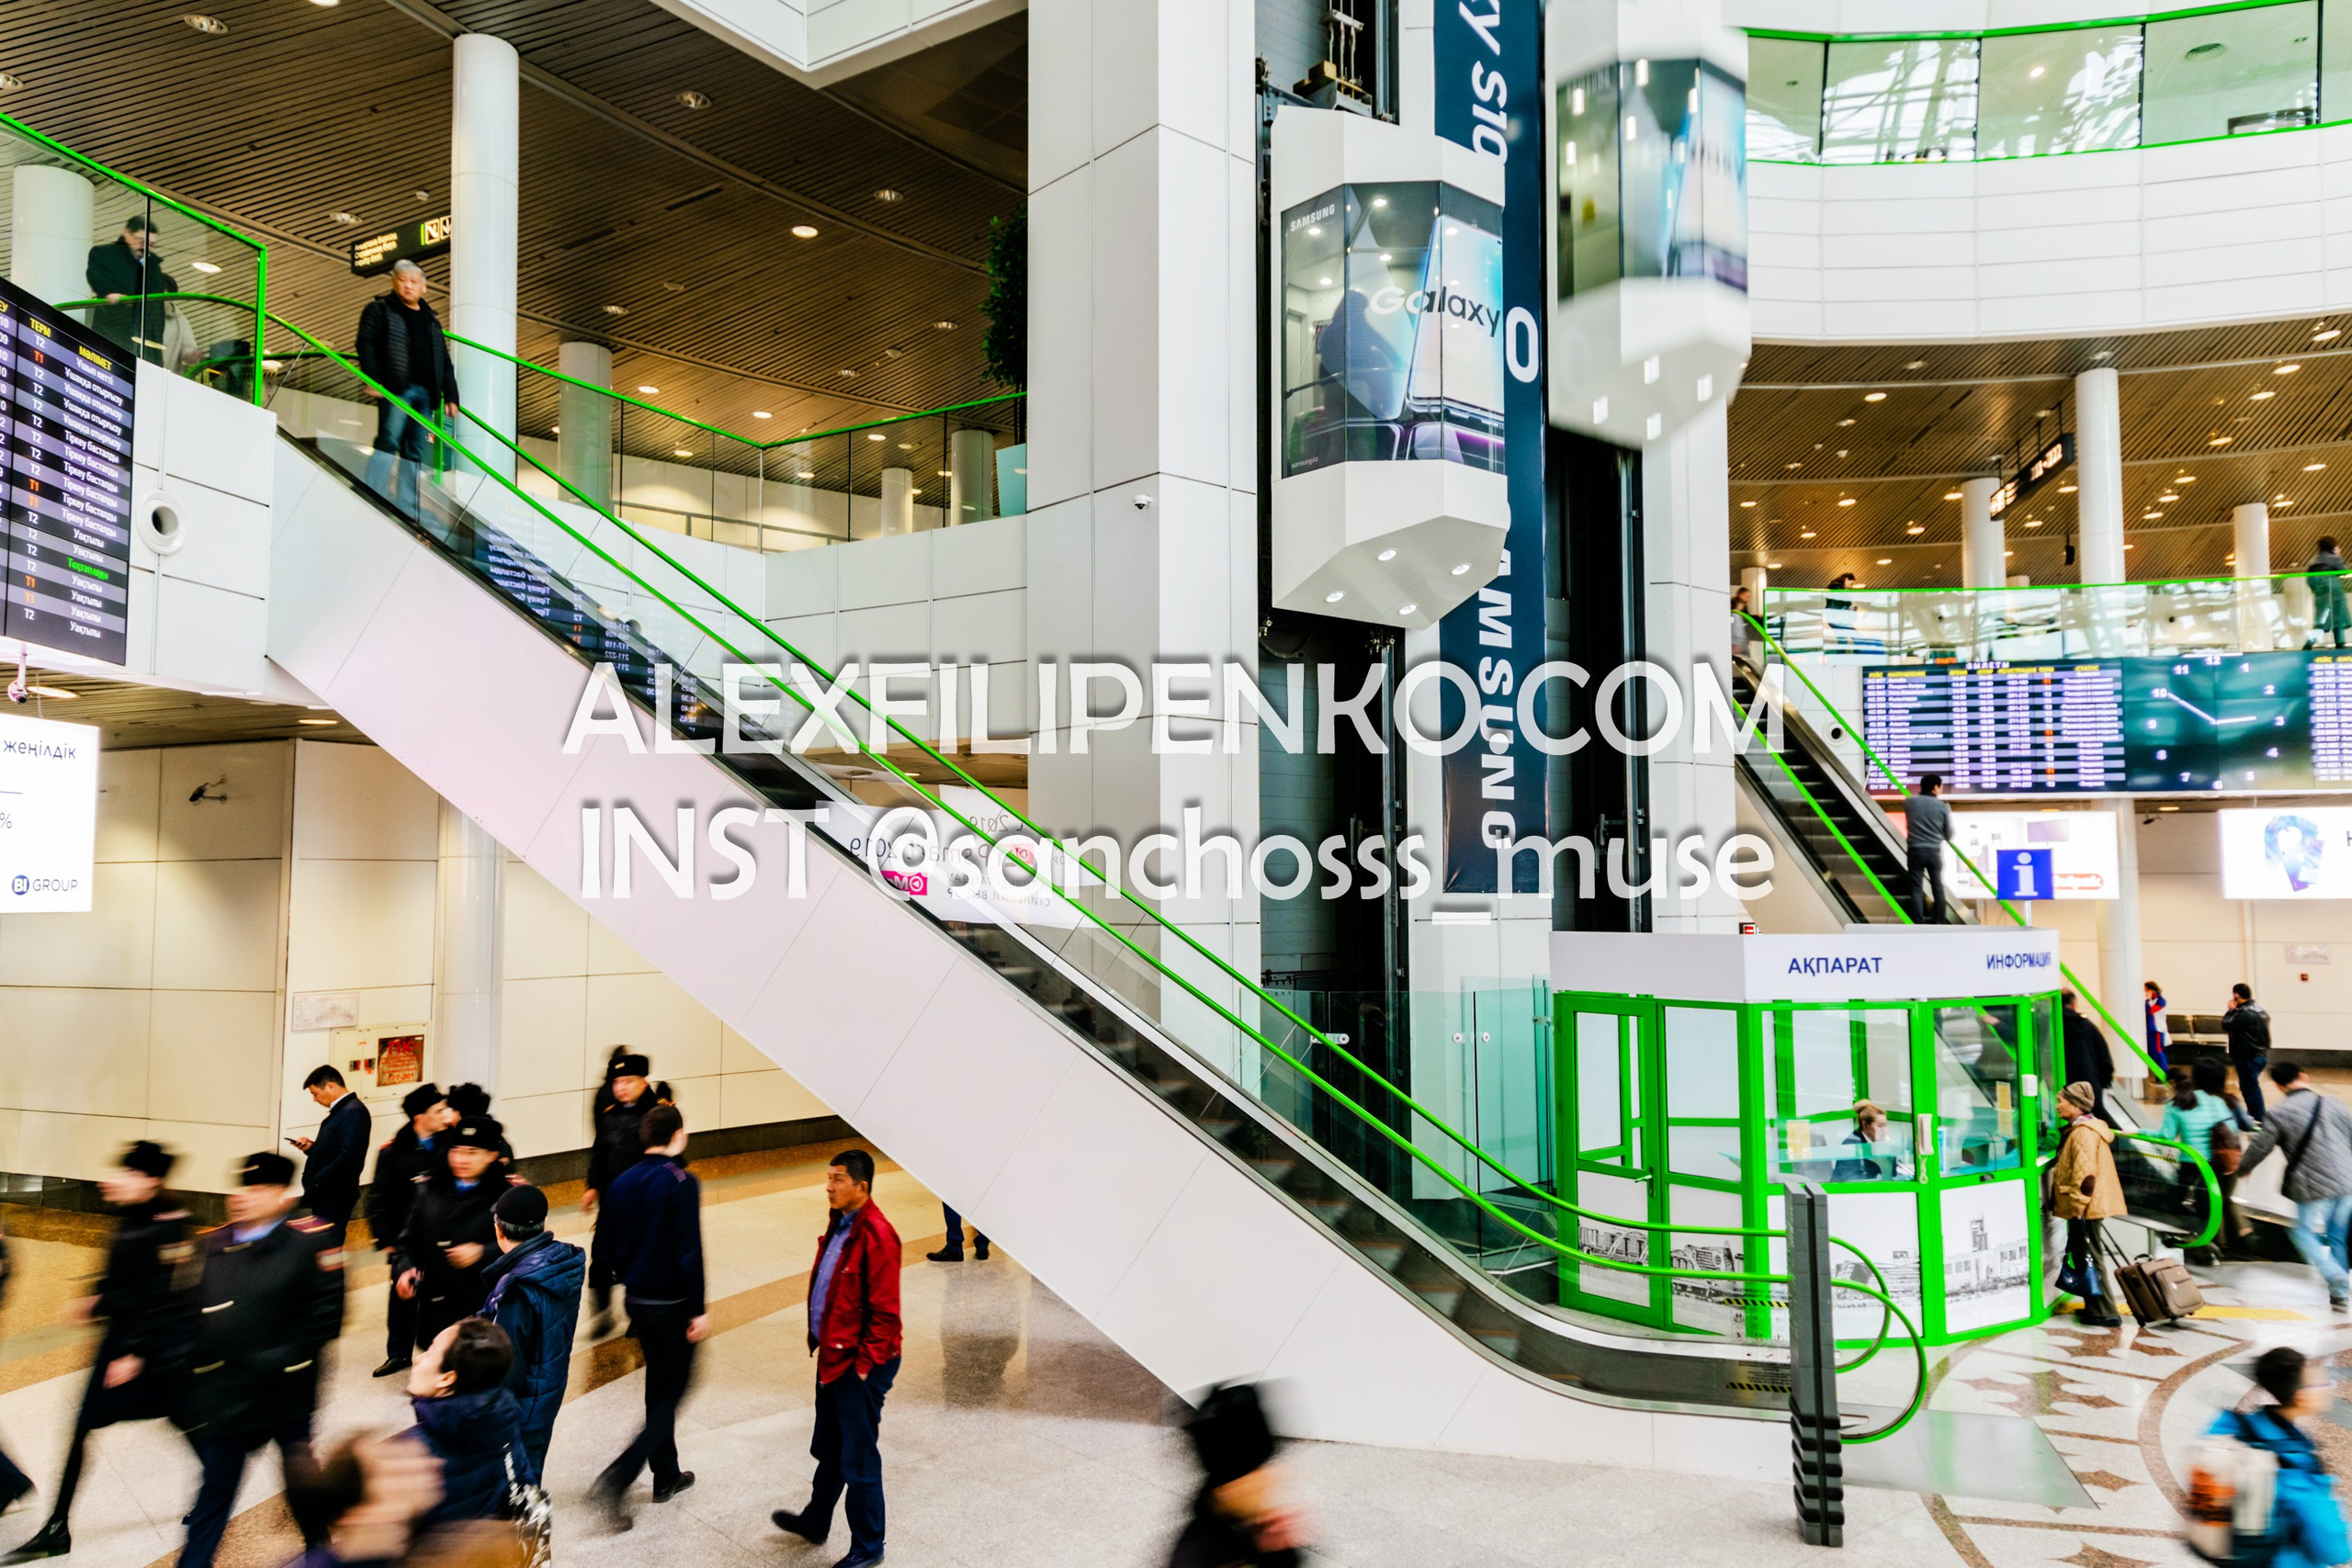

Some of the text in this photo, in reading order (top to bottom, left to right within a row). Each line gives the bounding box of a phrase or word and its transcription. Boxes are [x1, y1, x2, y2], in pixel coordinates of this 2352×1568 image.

[1291, 204, 1335, 231] SAMSUNG
[1370, 286, 1501, 338] Galaxy
[29, 318, 51, 338] ТЕРМ
[2206, 656, 2221, 665] 12
[2173, 665, 2188, 674] 11
[2241, 664, 2249, 672] 1
[2152, 688, 2167, 698] 10
[2264, 685, 2275, 694] 2
[1478, 549, 1516, 850] MSUNG
[2147, 719, 2157, 728] 9
[2274, 716, 2285, 726] 3
[3, 739, 76, 760] жеңілдік
[2267, 748, 2278, 758] 4
[2156, 750, 2167, 760] 8
[2180, 773, 2190, 782] 7
[2246, 772, 2255, 781] 5
[2212, 780, 2222, 790] 6
[32, 878, 78, 892] GROUP
[1788, 957, 1883, 976] АҚПАРАТ
